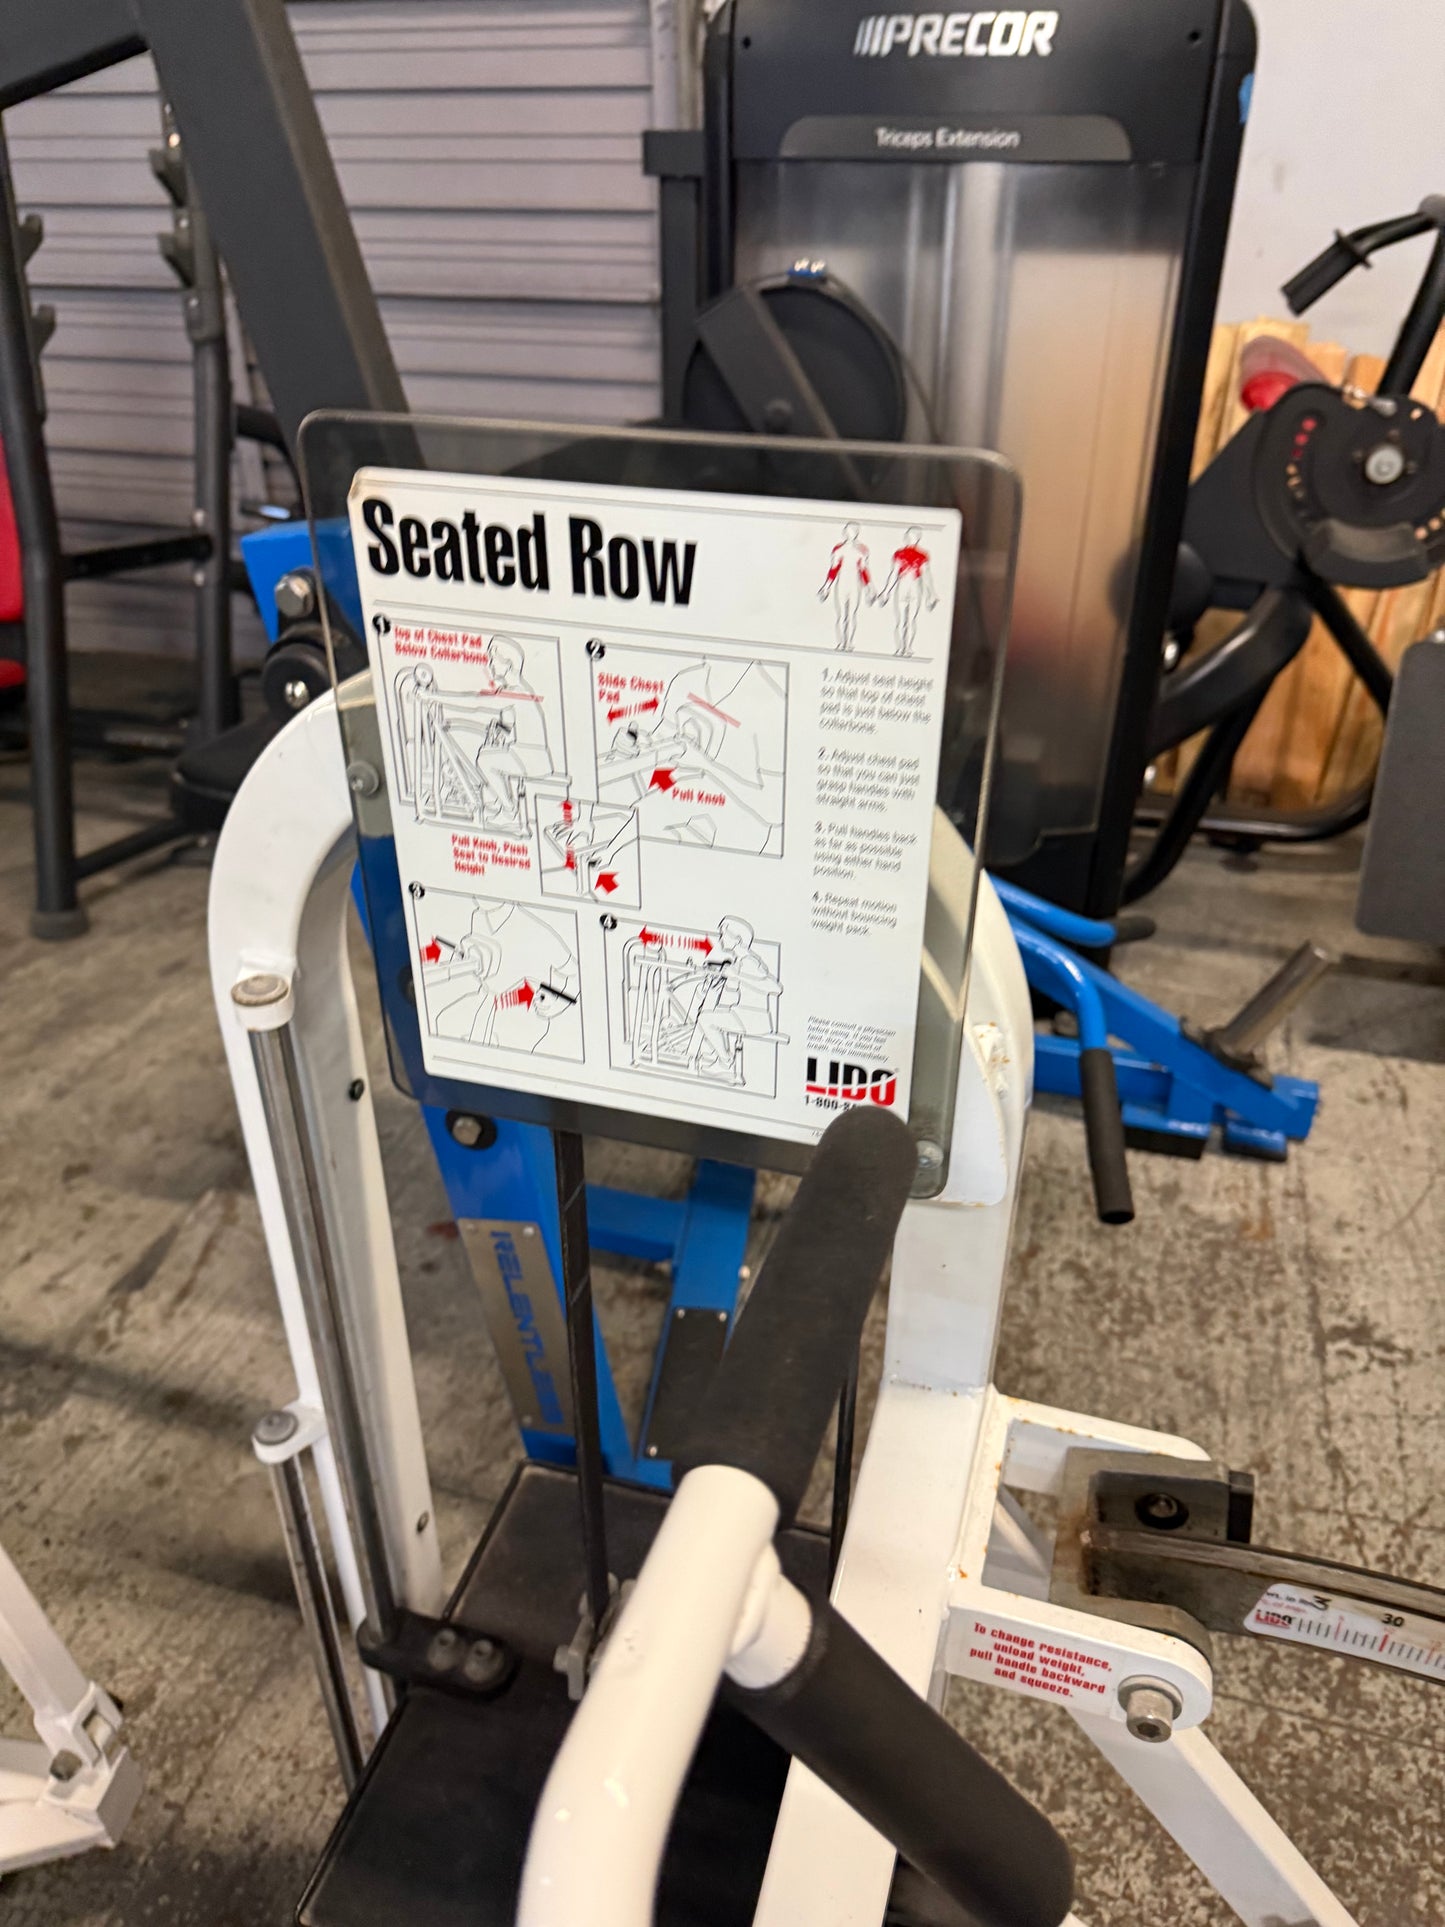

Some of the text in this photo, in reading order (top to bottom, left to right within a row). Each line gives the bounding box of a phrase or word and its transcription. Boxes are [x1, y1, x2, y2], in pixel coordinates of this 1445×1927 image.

[876, 10, 1059, 57] PRECOR
[875, 126, 1021, 150] Triceps Extension
[361, 497, 698, 608] Seated Row
[414, 628, 424, 640] of
[427, 628, 458, 646] Chest
[462, 633, 482, 648] Pad
[395, 642, 489, 666] Below Collarbone
[597, 672, 665, 693] Slide Chest
[835, 668, 871, 686] Adjust
[872, 674, 896, 688] seat
[897, 675, 934, 693] height
[598, 690, 621, 704] Pad
[820, 685, 926, 707] so that top of chest
[820, 701, 932, 725] pad is just below the
[819, 717, 878, 735] collarbone.
[817, 746, 920, 771] 2. Adjust chest pad
[817, 763, 920, 786] so that you can just
[672, 788, 726, 807] Pull Knob
[816, 779, 915, 801] grasp handles with
[816, 793, 856, 809] straight
[451, 833, 529, 856] Pull Knob, Push
[828, 822, 848, 837] Pull
[849, 825, 890, 842] handles
[892, 830, 918, 846] back
[814, 836, 903, 858] as far as possible
[453, 846, 531, 871] Seat to Desired
[454, 861, 486, 876] Height
[814, 851, 901, 872] using either hand
[824, 891, 860, 907] Repeat
[861, 900, 897, 913] motion
[812, 905, 897, 928] without bouncing
[812, 918, 844, 933] weight
[807, 1015, 830, 1026] Please
[830, 1020, 857, 1031] consult
[863, 1024, 896, 1037] physician
[807, 1025, 829, 1035] before
[859, 1033, 873, 1042] you
[874, 1035, 887, 1043] feel
[831, 1045, 847, 1056] stop
[854, 1040, 873, 1050] short
[806, 1056, 897, 1107] LIDO
[1254, 1608, 1293, 1629] LIDO
[1381, 1612, 1405, 1629] 30
[974, 1621, 1113, 1673] To change resistance,
[993, 1641, 1086, 1677] unload weight,
[969, 1647, 1106, 1694] pull handle backward
[994, 1666, 1075, 1698] and squeeze.
